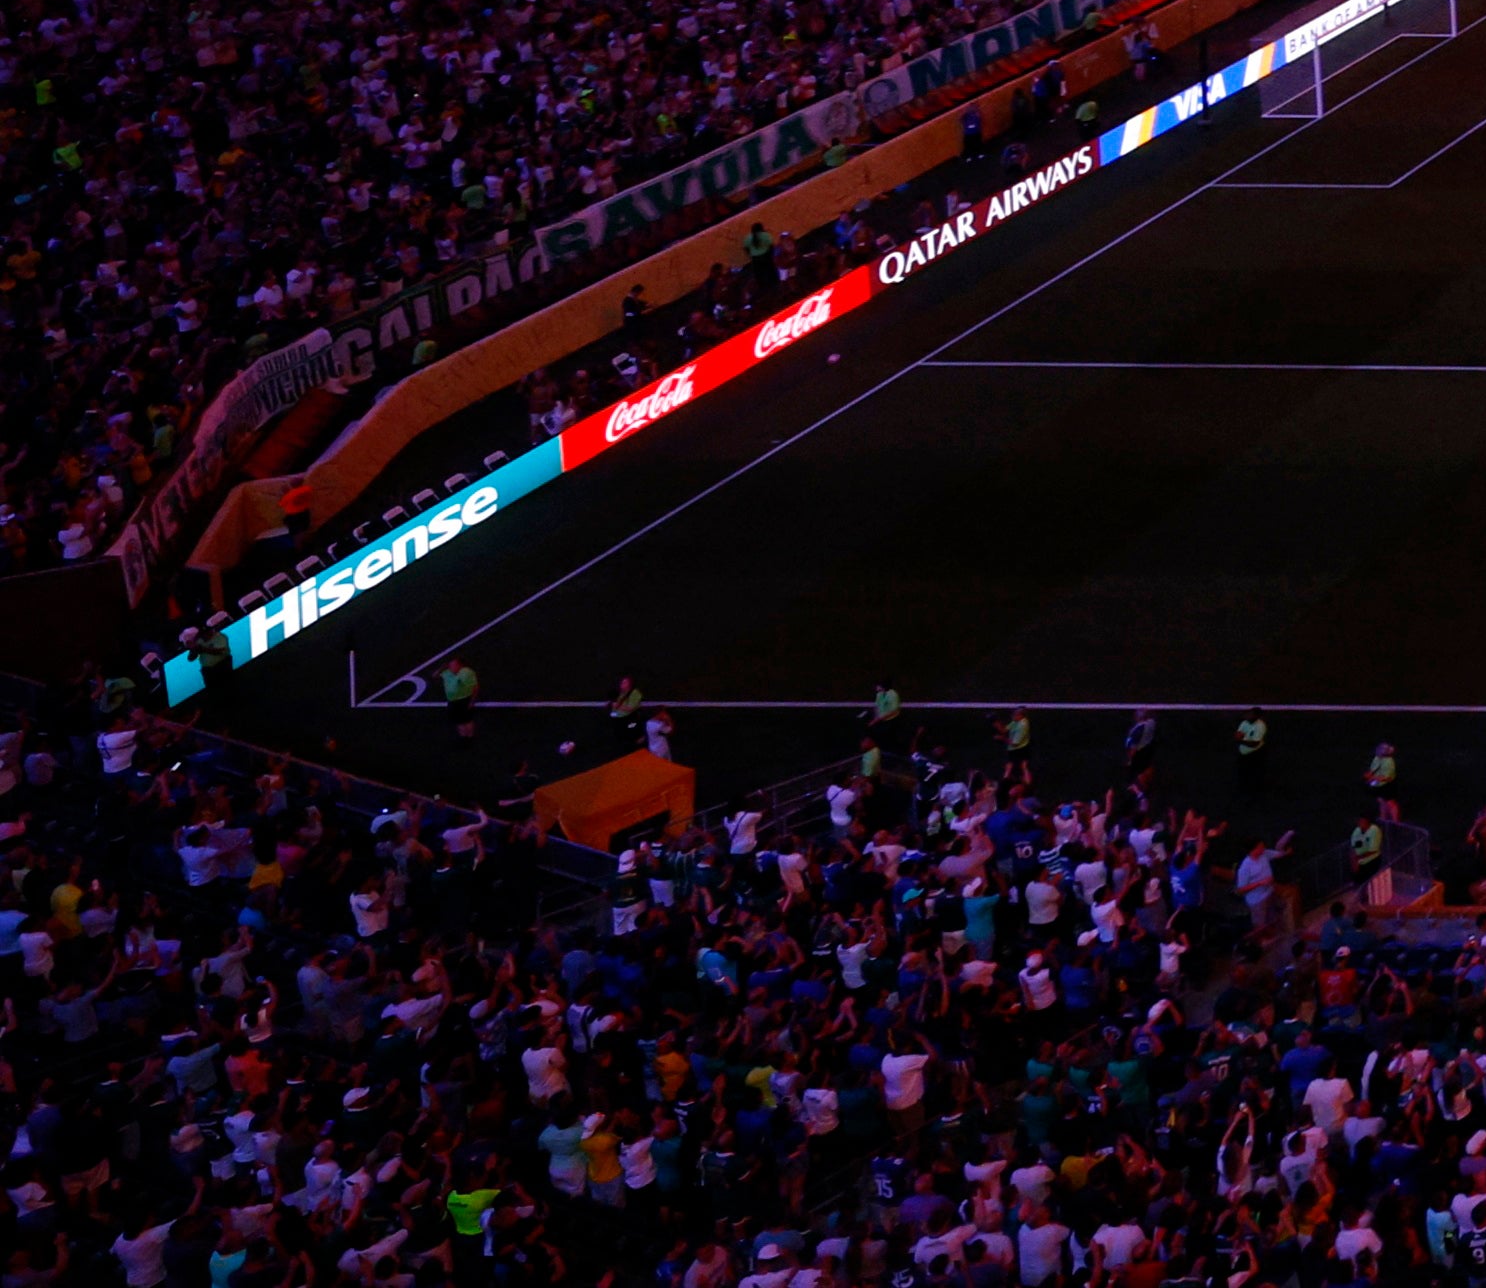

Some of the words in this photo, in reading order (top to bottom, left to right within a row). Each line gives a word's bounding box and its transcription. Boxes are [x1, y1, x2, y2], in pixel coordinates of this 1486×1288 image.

[1288, 20, 1329, 54] BANK
[878, 210, 977, 285] QATAR
[985, 146, 1094, 228] AIRWAYS
[249, 485, 499, 659] Hisense
